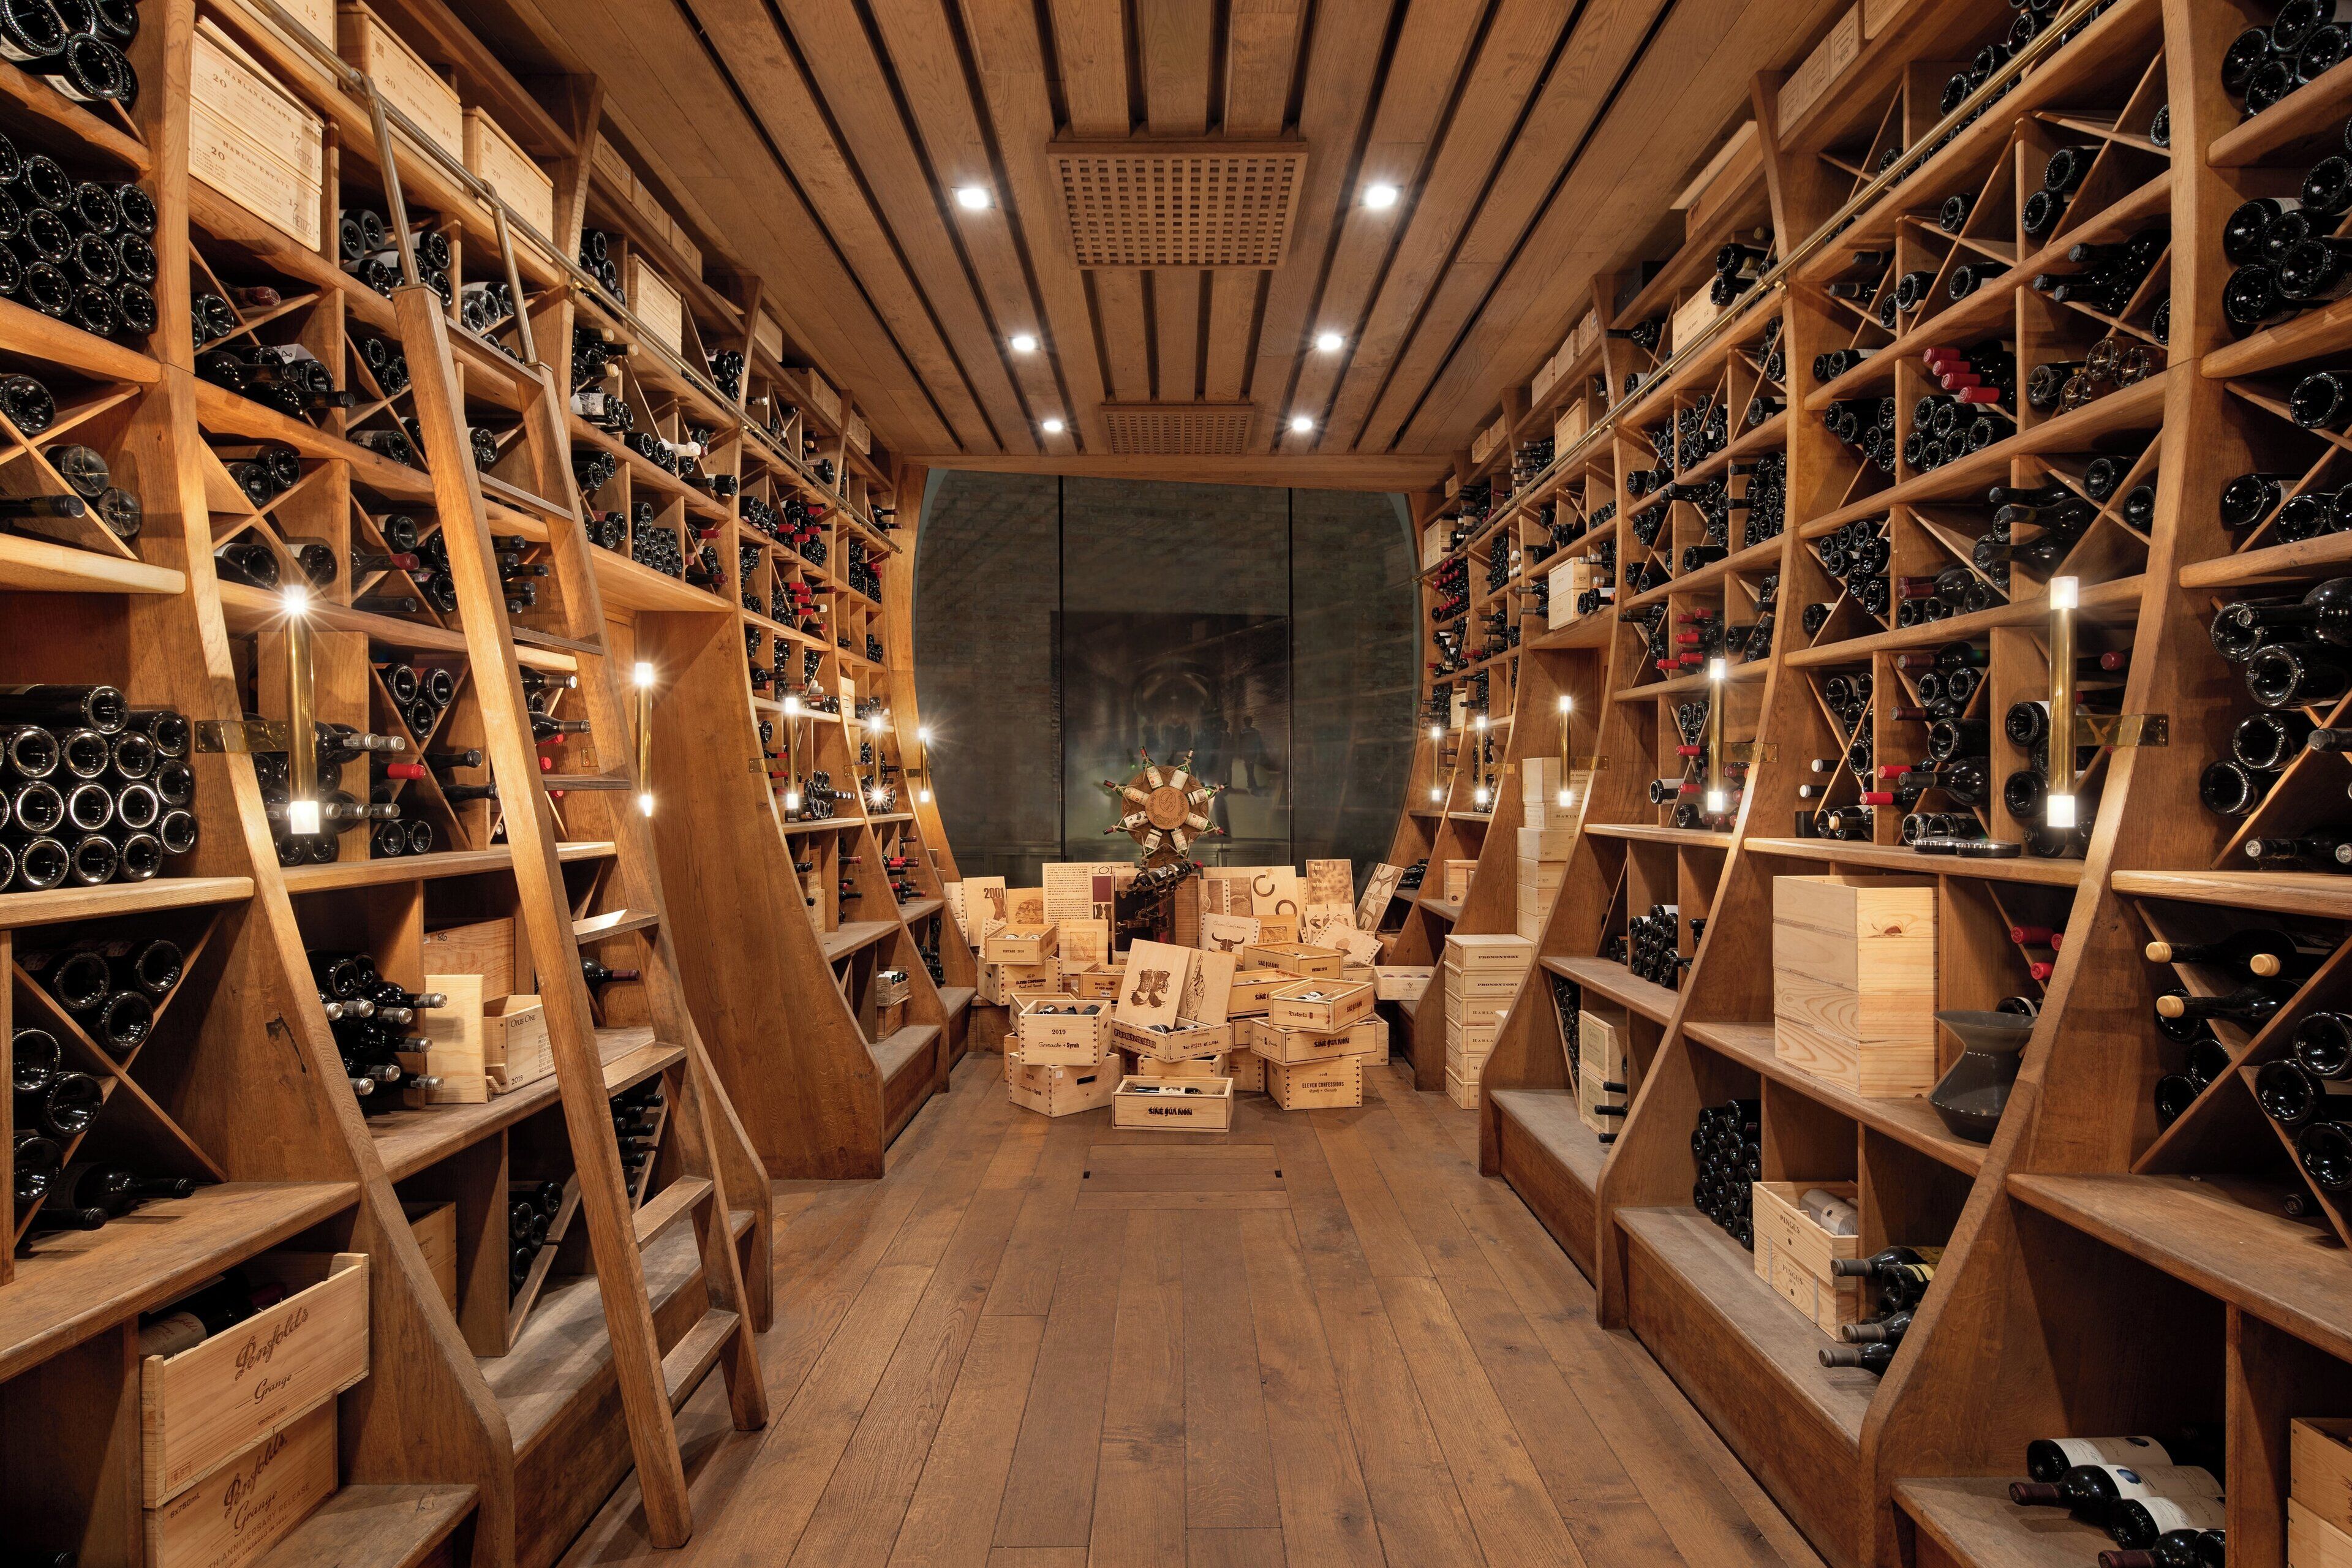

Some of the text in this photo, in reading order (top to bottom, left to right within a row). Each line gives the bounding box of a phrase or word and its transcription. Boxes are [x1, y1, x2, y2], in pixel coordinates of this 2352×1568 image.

[306, 4, 317, 20] 12
[407, 60, 431, 88] BOND
[213, 74, 227, 88] 20
[290, 131, 301, 145] 17
[224, 68, 258, 98] HARLAN
[261, 96, 292, 123] ESTATE
[385, 75, 396, 89] 20
[441, 127, 451, 140] 10
[211, 146, 225, 161] 20
[288, 198, 299, 213] 17
[222, 139, 257, 168] HARLAN
[260, 165, 290, 190] ESTATE
[509, 153, 529, 174] BOND
[492, 168, 544, 218] 20 10
[984, 887, 1005, 899] 2001
[511, 1074, 524, 1086] 2018
[1780, 1215, 1800, 1234] PINGUS
[1782, 1264, 1803, 1285] PINGUS
[235, 1306, 309, 1382] Penfolds
[254, 1373, 292, 1405] Grange
[170, 1492, 201, 1519] 6x750mL
[234, 1490, 277, 1537] Grange
[221, 1511, 276, 1562] ANNIVERSARY
[278, 1482, 311, 1513] RELEASE
[243, 1531, 268, 1556] VINTAGED
